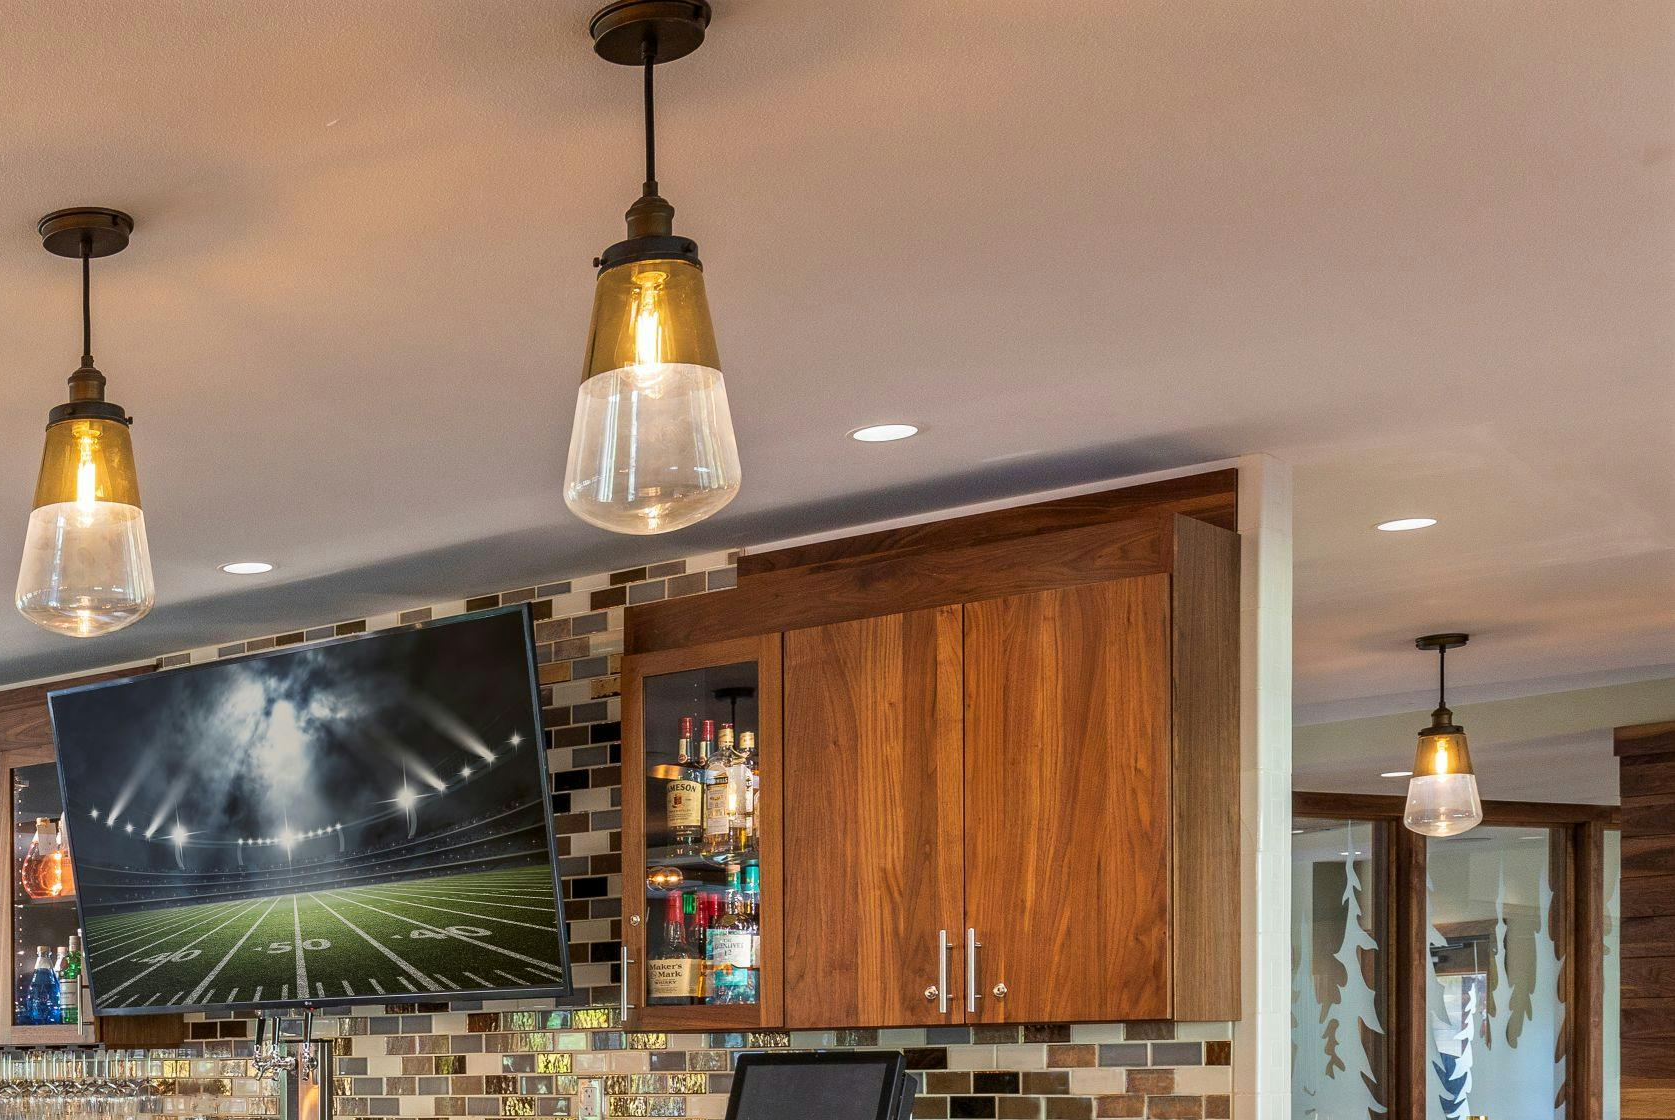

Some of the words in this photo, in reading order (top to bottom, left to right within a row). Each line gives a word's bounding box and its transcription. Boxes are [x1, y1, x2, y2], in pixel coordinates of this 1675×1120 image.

[266, 938, 332, 954] 50
[649, 963, 683, 971] Maker's
[658, 970, 683, 978] Mark
